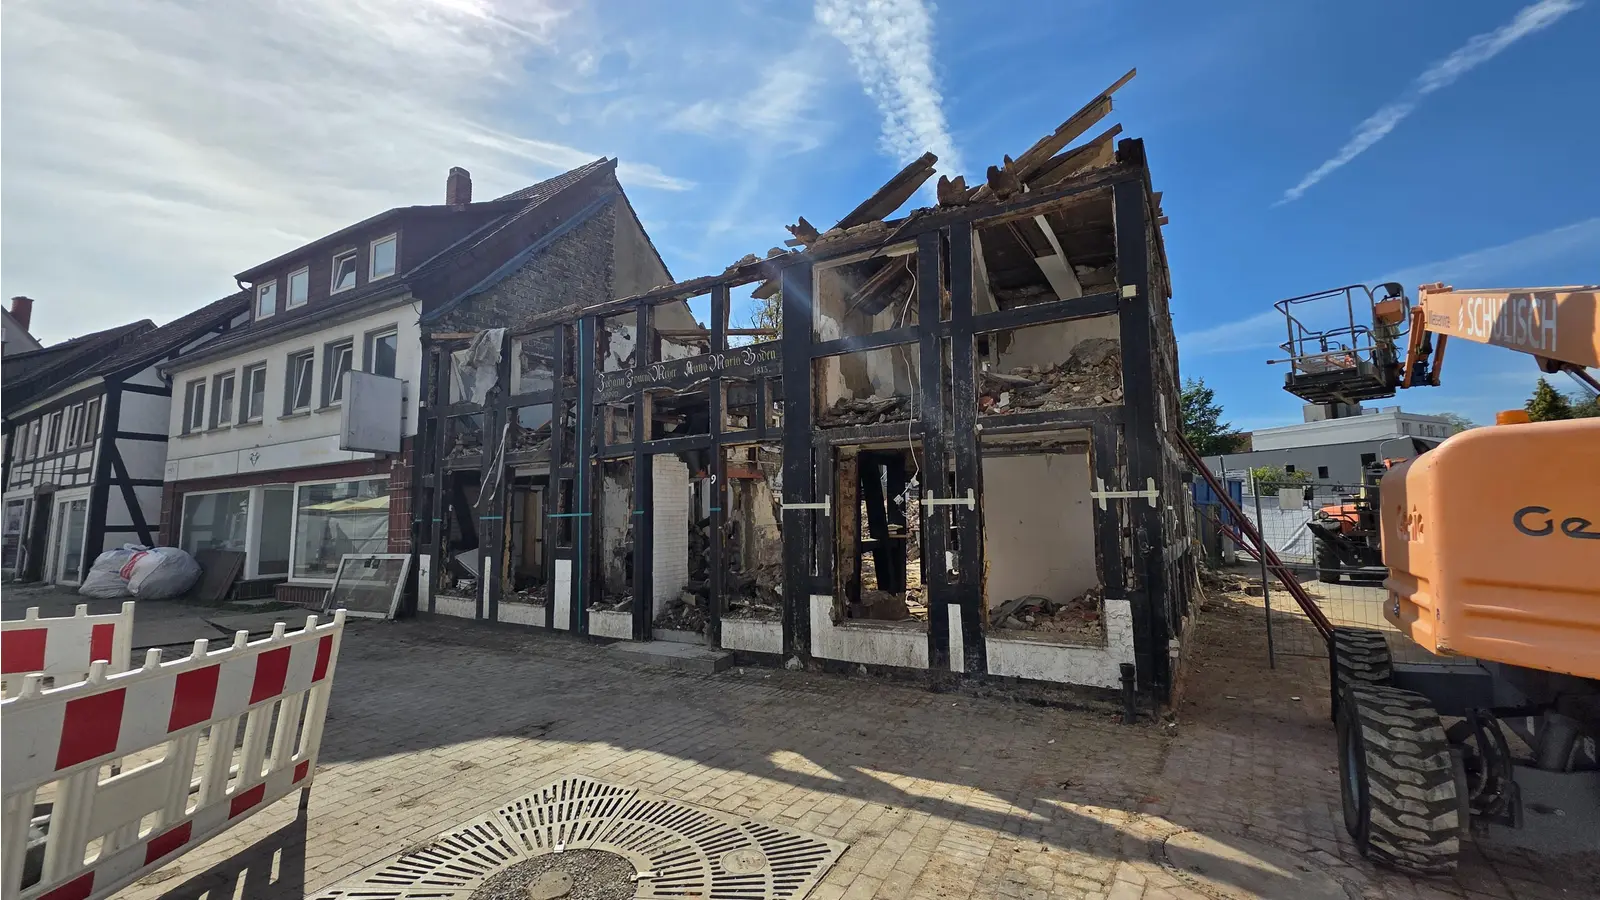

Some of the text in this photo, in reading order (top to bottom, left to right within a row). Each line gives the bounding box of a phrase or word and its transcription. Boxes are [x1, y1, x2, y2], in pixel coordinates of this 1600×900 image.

[1468, 297, 1556, 352] SCHULISCH
[684, 360, 708, 377] Anna
[709, 354, 741, 372] Maria
[711, 474, 717, 485] 9
